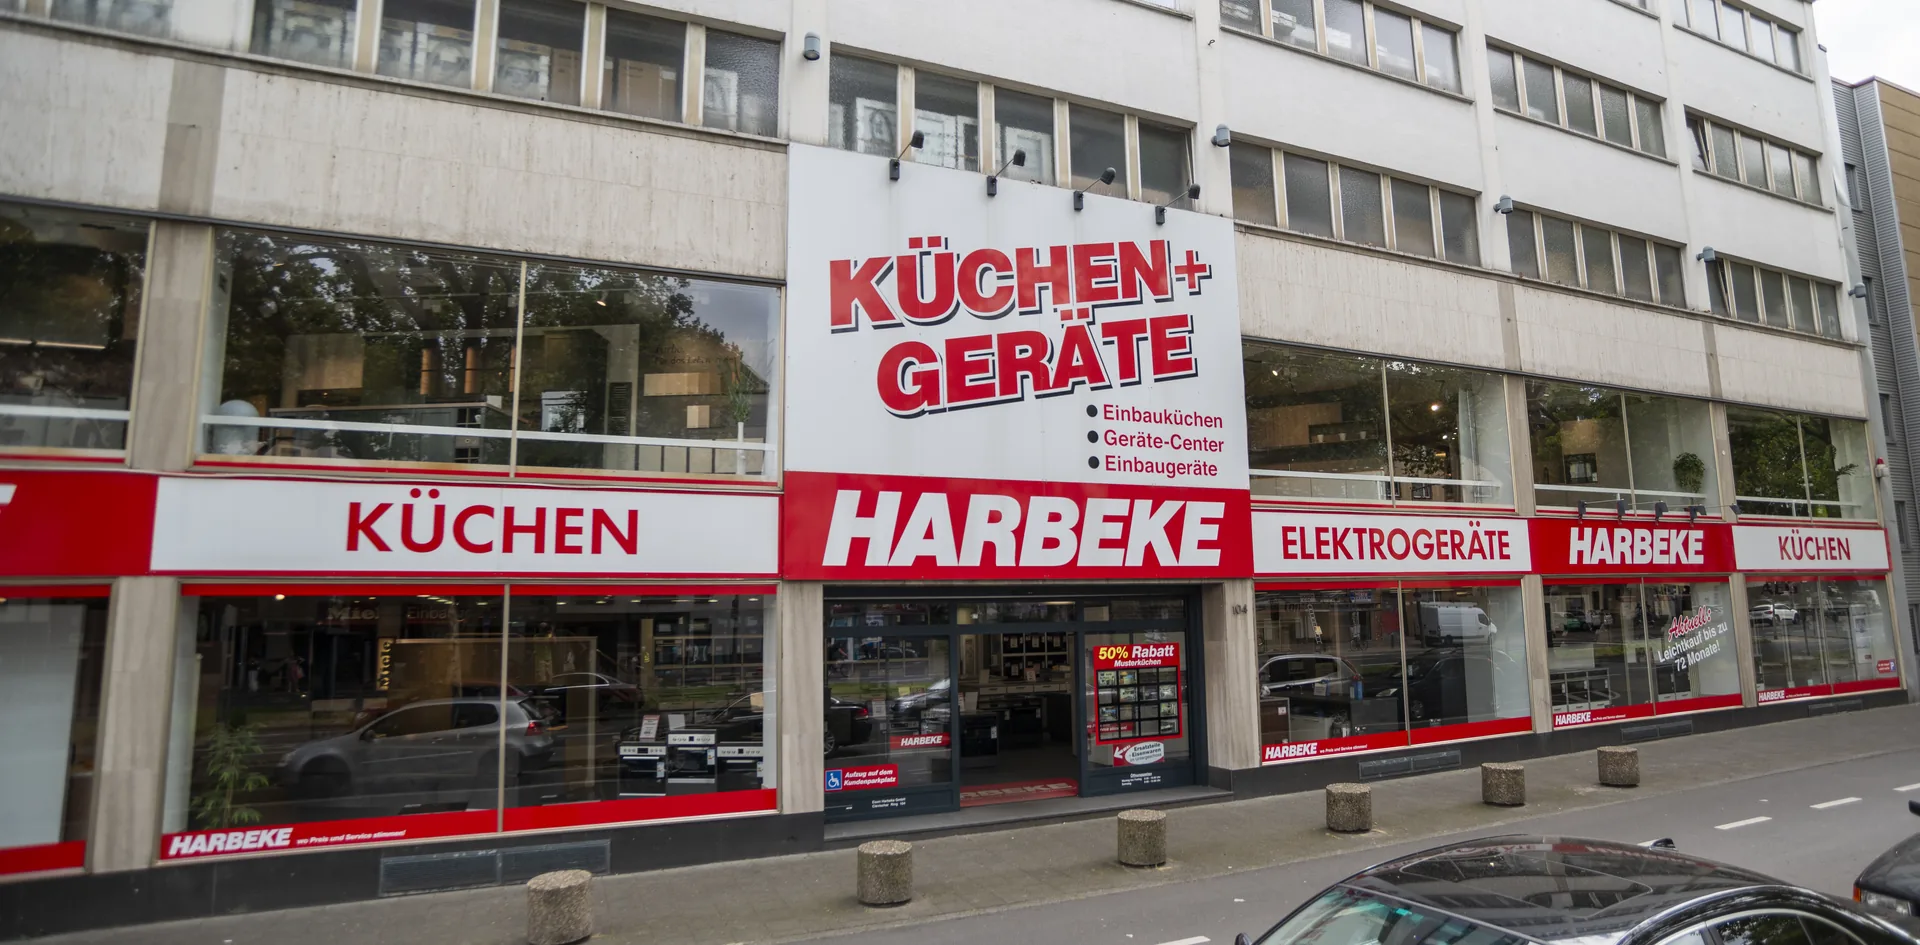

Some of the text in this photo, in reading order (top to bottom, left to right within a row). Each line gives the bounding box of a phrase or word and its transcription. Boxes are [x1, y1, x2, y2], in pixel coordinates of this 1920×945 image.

[829, 235, 1212, 334] KÜCHEN+
[876, 307, 1198, 419] GERÄTE
[1103, 403, 1224, 429] Einbauküchen
[1103, 430, 1225, 453] Geräte-Center
[1104, 454, 1218, 479] Einbaugeräte
[346, 488, 639, 555] KÜCHEN
[822, 489, 1226, 567] HARBEKE
[1281, 520, 1511, 561] ELEKTROGERÄTE
[1568, 527, 1705, 565] HARBEKE
[1777, 529, 1852, 561] KÜCHEN
[1231, 603, 1248, 615] 104
[1668, 605, 1712, 642] Aktuell:
[1098, 645, 1174, 660] 50% Rabatt
[1658, 621, 1728, 663] Leichtkauf bis zu
[1114, 659, 1162, 667] Musterküchen
[1675, 640, 1721, 671] 72 Monate!
[1758, 690, 1785, 702] HARBEKE
[1555, 711, 1591, 726] HARBEKE
[900, 735, 943, 746] HARBEKE
[1265, 742, 1318, 760] HARBEKE
[843, 776, 896, 787] Kundenparkplatz
[844, 771, 867, 779] Aufzug
[168, 827, 294, 857] HARBEKE
[309, 836, 329, 844] Preis
[330, 834, 345, 842] und
[345, 832, 372, 841] Service
